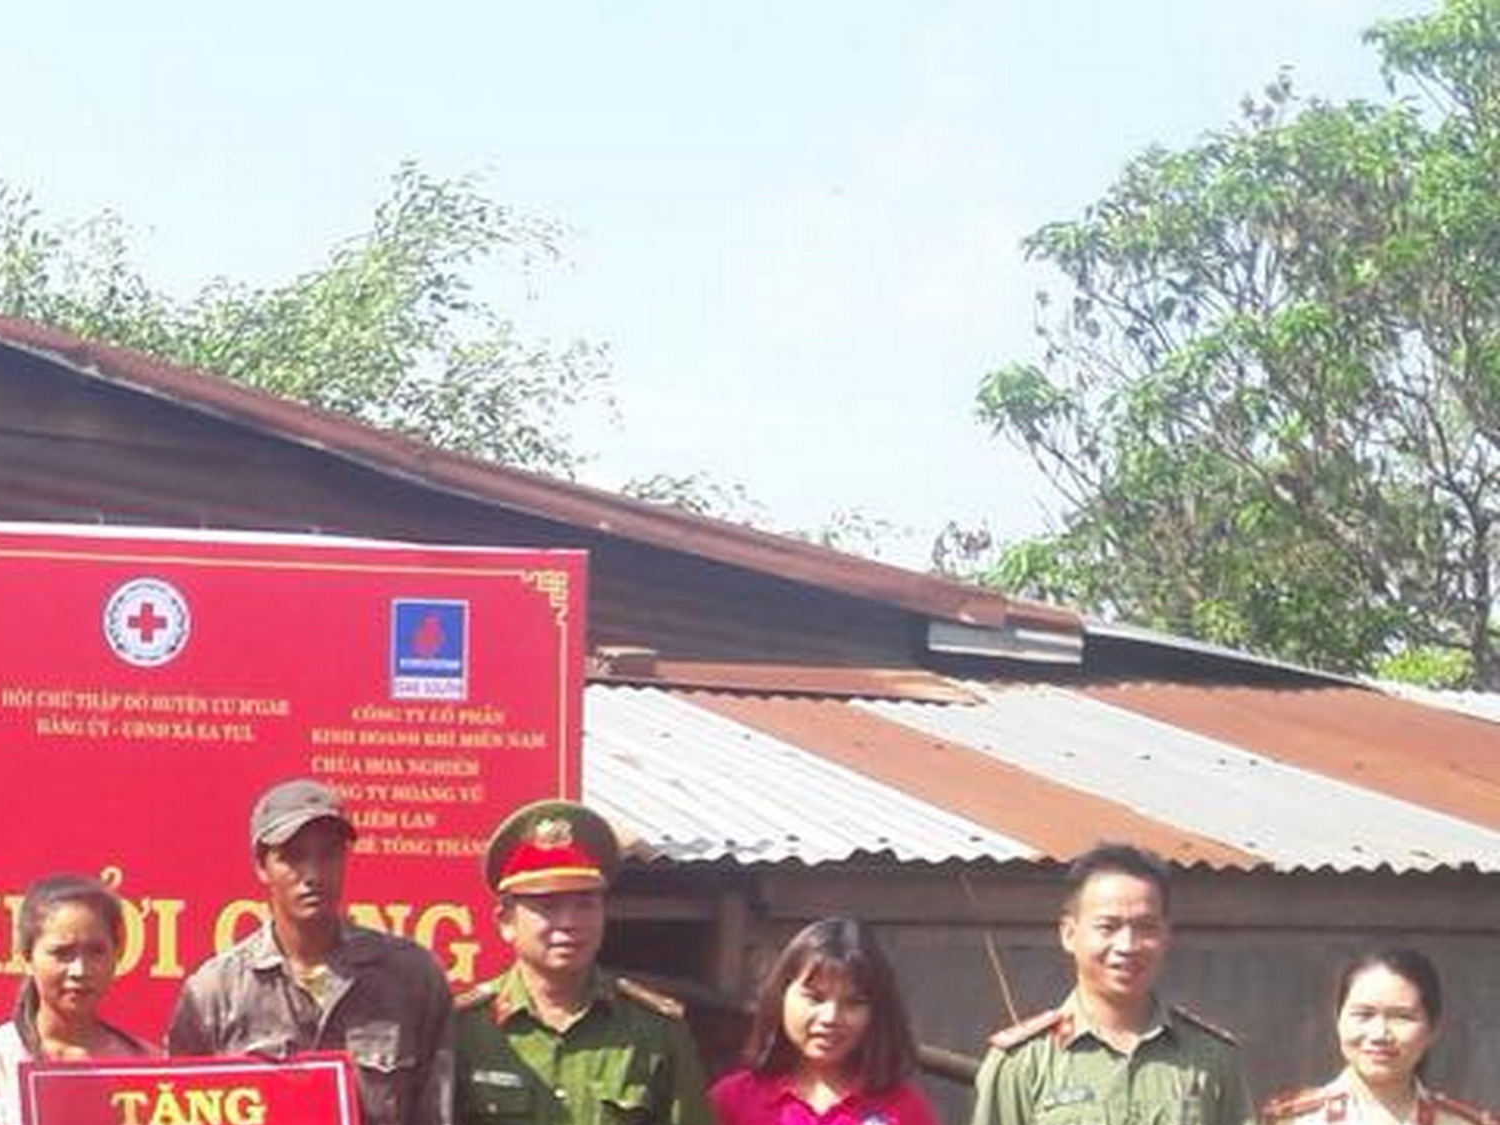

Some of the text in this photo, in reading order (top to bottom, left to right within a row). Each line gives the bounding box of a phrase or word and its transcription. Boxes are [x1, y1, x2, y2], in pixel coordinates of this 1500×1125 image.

[352, 703, 401, 722] CÔNG
[404, 706, 425, 723] TY
[311, 728, 355, 745] KINH
[358, 729, 420, 746] DOANH
[507, 732, 547, 749] NAM
[366, 784, 389, 801] TY
[401, 812, 437, 829] LAN
[214, 899, 481, 982] CG
